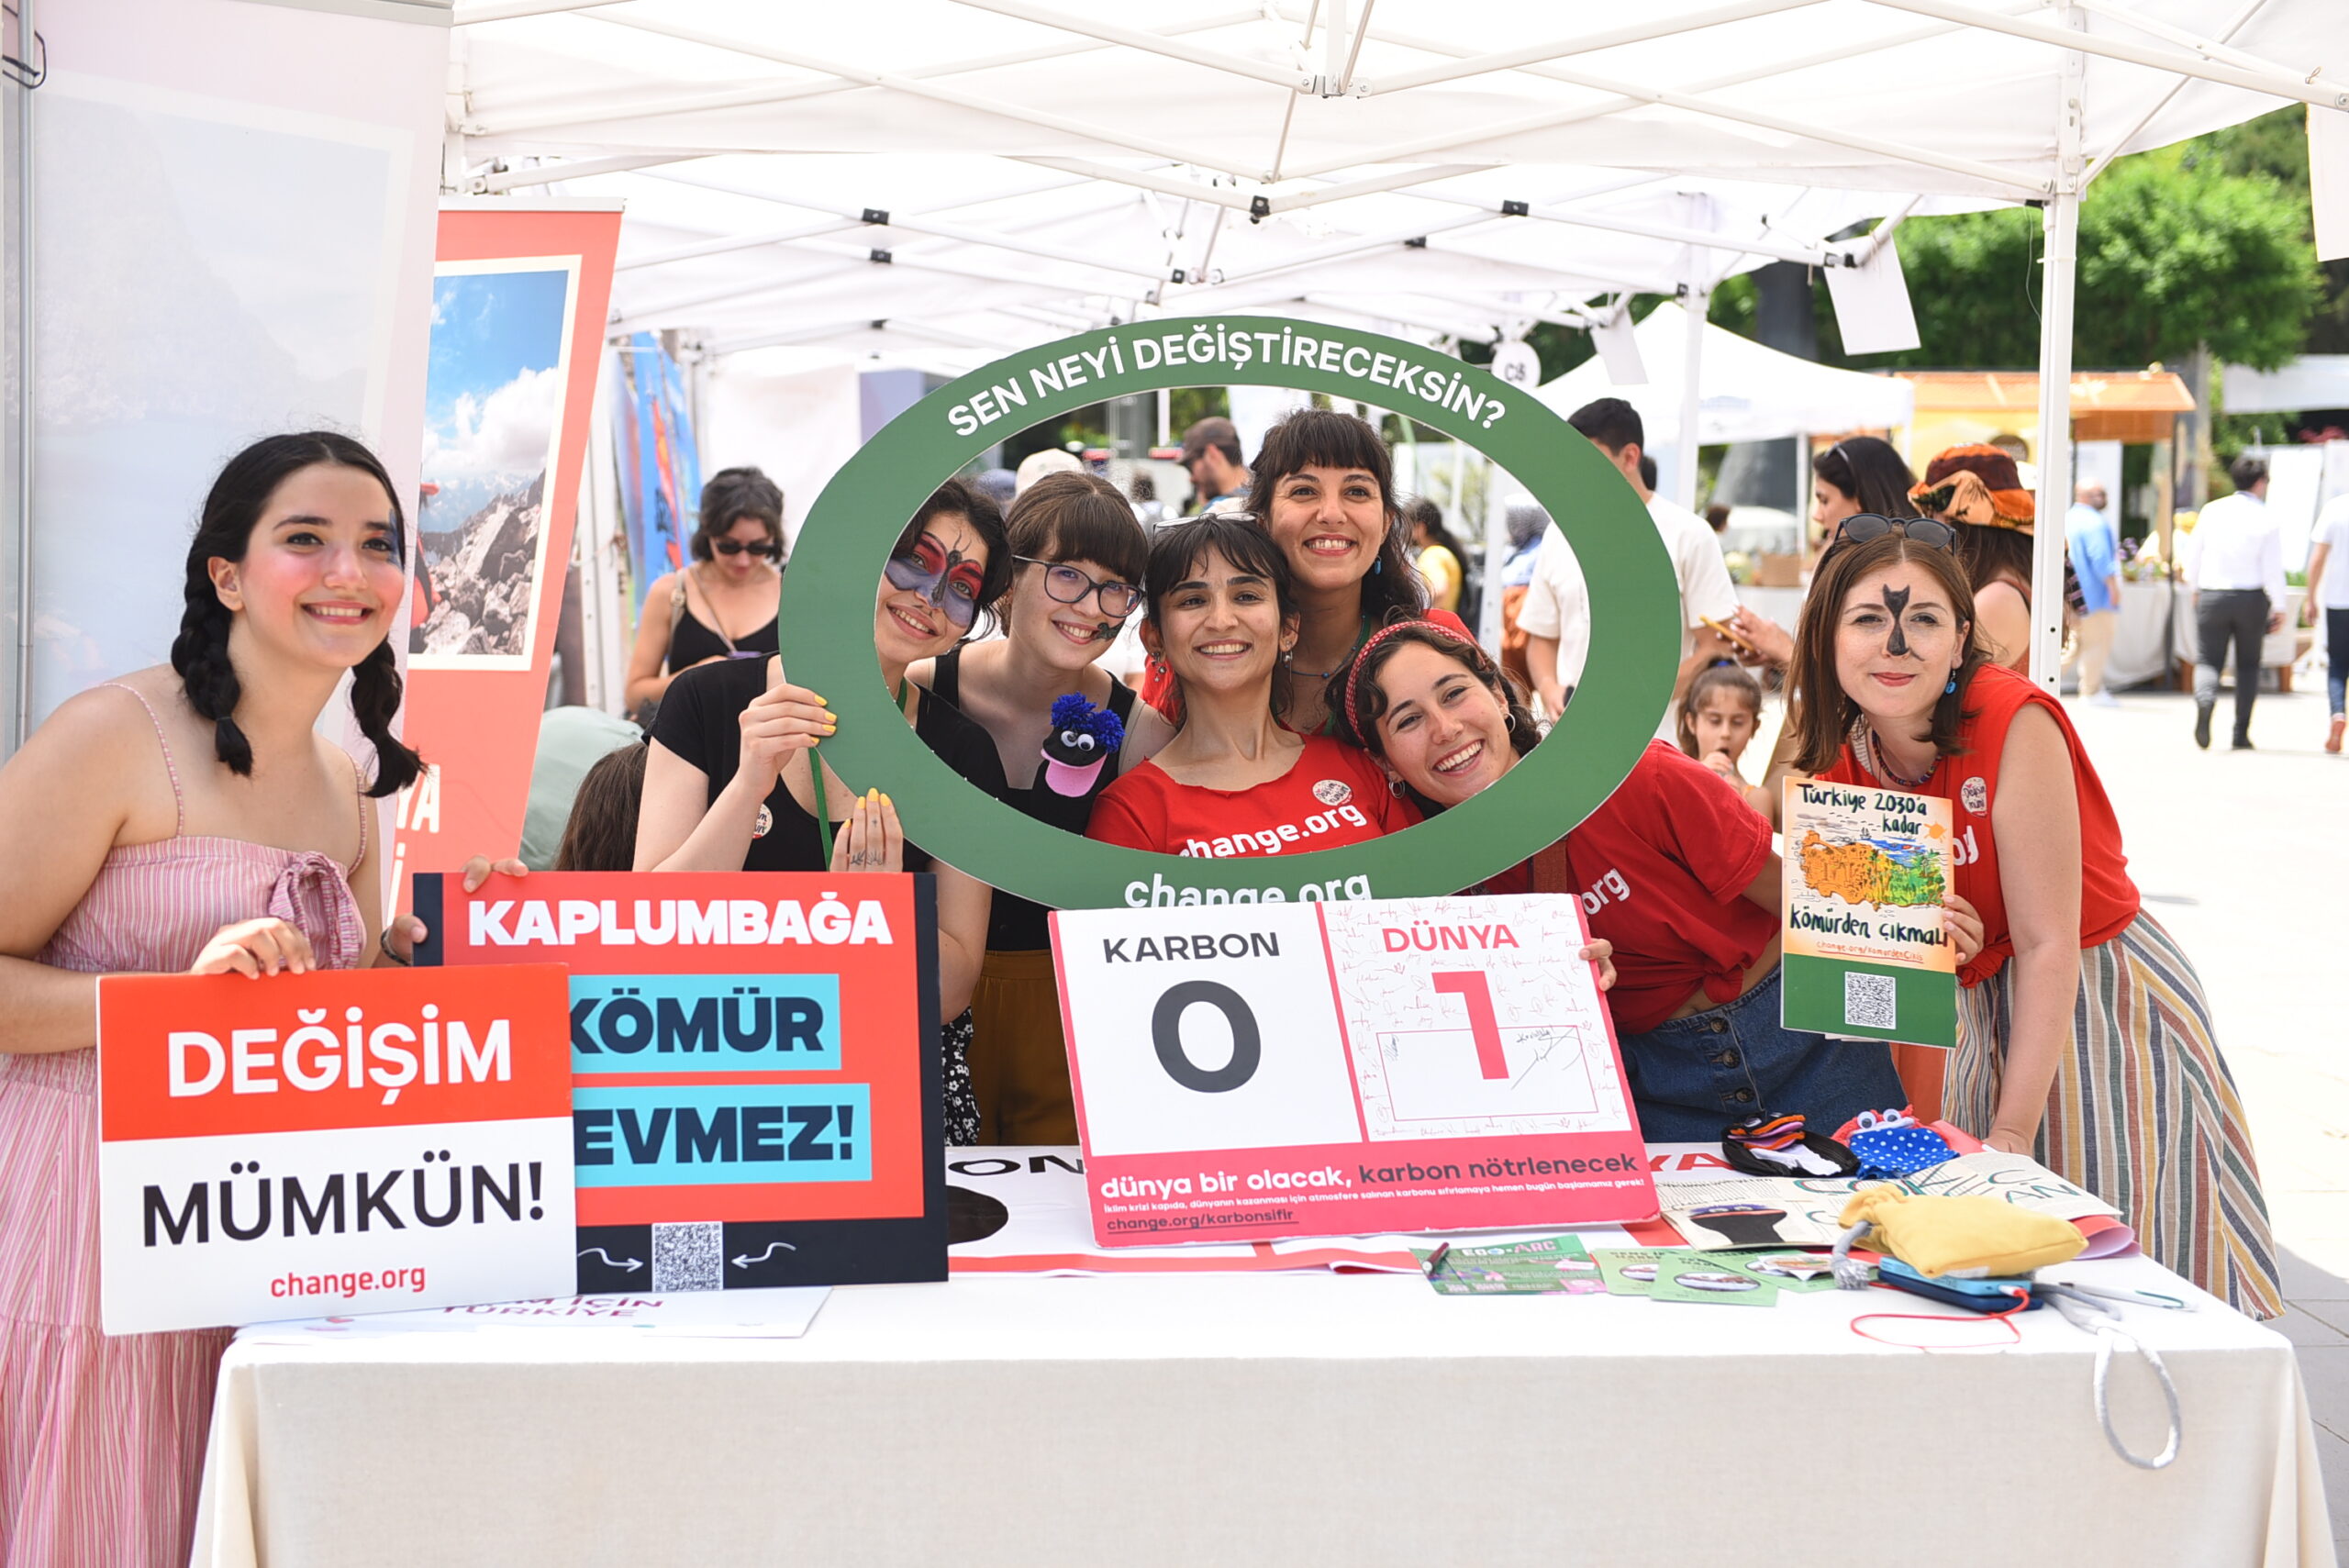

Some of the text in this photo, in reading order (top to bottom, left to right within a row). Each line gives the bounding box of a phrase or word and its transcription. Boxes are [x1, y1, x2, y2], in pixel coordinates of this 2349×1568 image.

[948, 323, 1506, 436] SEN NEYİ DEĞİŞTİRECEKSİN?
[1124, 873, 1372, 908] changeorg
[468, 891, 894, 946] KAPLUMBAĞA
[1103, 919, 1520, 964] KARBON DÜNYA
[1431, 970, 1509, 1080] 1
[168, 1004, 512, 1105] DEĞİŞİM
[573, 1104, 854, 1166] EVMEZ!
[143, 1149, 544, 1248] MÜMKÜN!
[1100, 1153, 1640, 1200] dünya bir olacak, karbon nötrlenecek
[1129, 1203, 1150, 1212] krizi
[1308, 1192, 1358, 1202] atmosfere
[1396, 1187, 1436, 1197] karbonu
[1492, 1184, 1524, 1193] hemen
[270, 1266, 426, 1299] change.org
